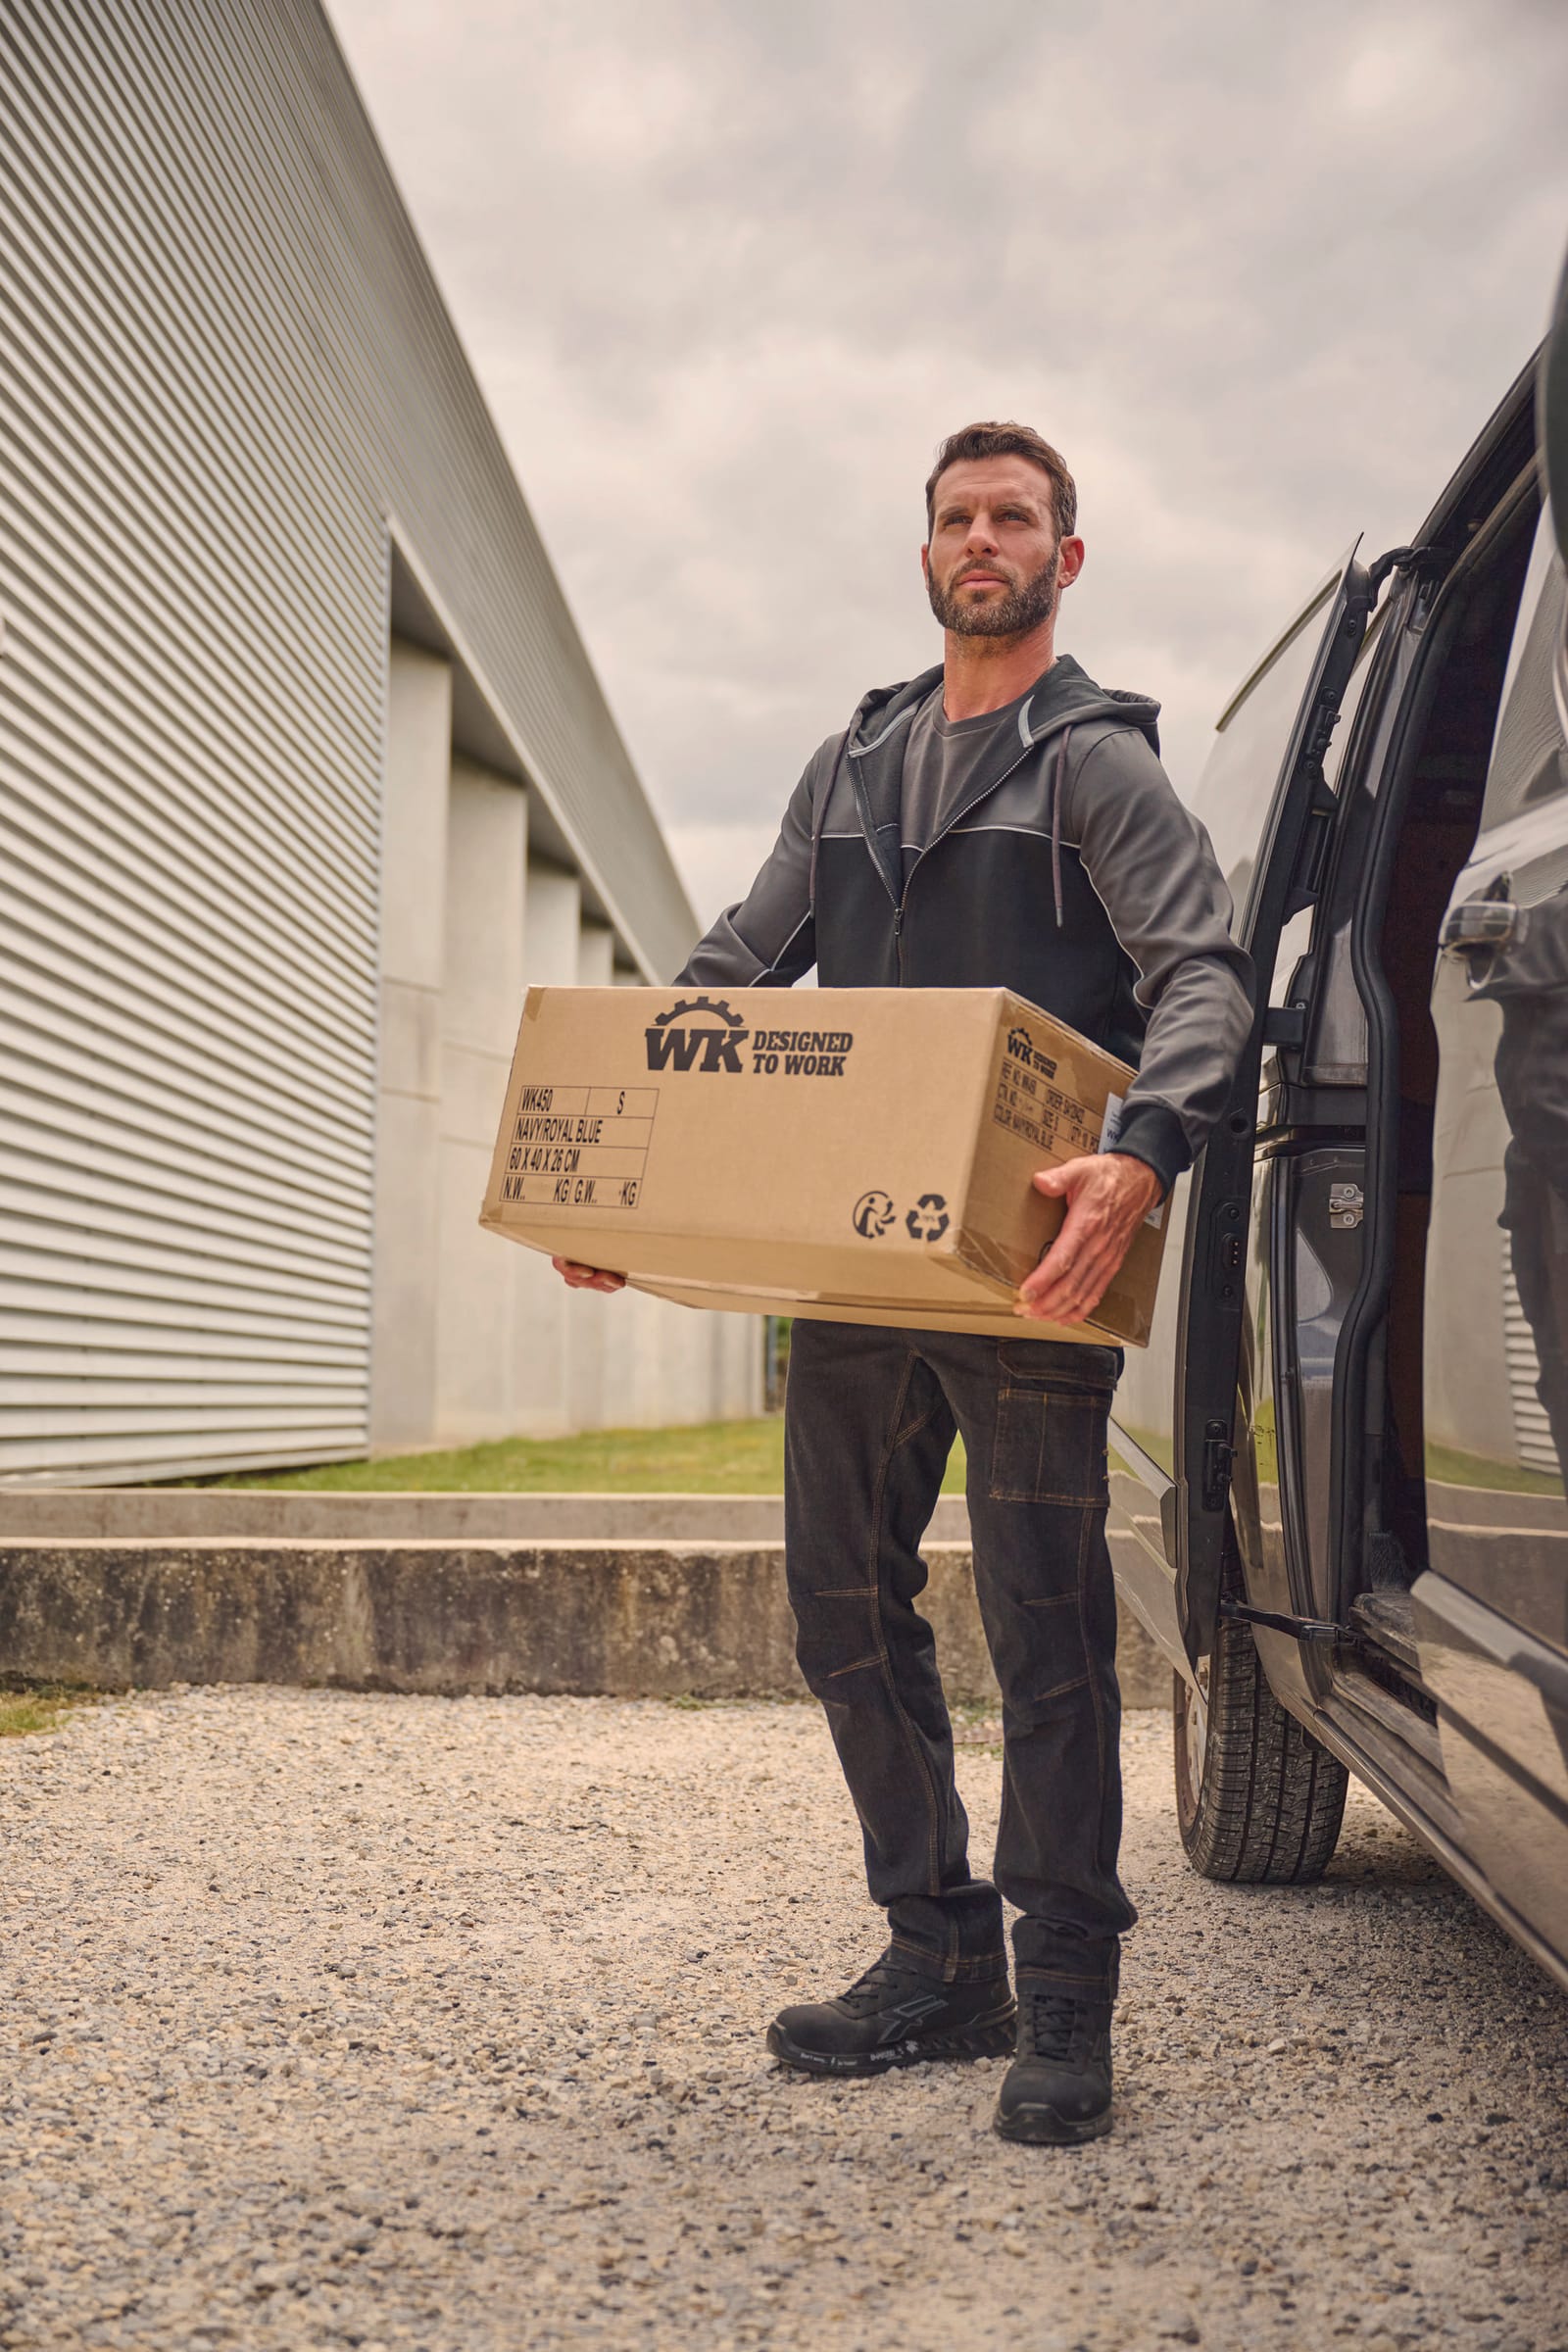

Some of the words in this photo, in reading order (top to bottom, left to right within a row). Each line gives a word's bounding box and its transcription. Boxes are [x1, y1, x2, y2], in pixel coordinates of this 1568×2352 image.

[645, 1028, 750, 1073] WK
[753, 1031, 854, 1054] DESIGNED
[1007, 1034, 1034, 1065] WK
[753, 1054, 779, 1074] TO
[784, 1055, 847, 1077] WORK
[521, 1088, 553, 1111] WK450
[616, 1091, 625, 1114] S
[575, 1119, 603, 1144] BLUE
[510, 1148, 521, 1170] 60
[520, 1148, 530, 1171] X
[530, 1148, 543, 1171] 40
[542, 1149, 553, 1171] X
[551, 1150, 564, 1172] 26
[564, 1150, 580, 1173] CM
[554, 1179, 569, 1202] KG
[620, 1182, 637, 1206] KG
